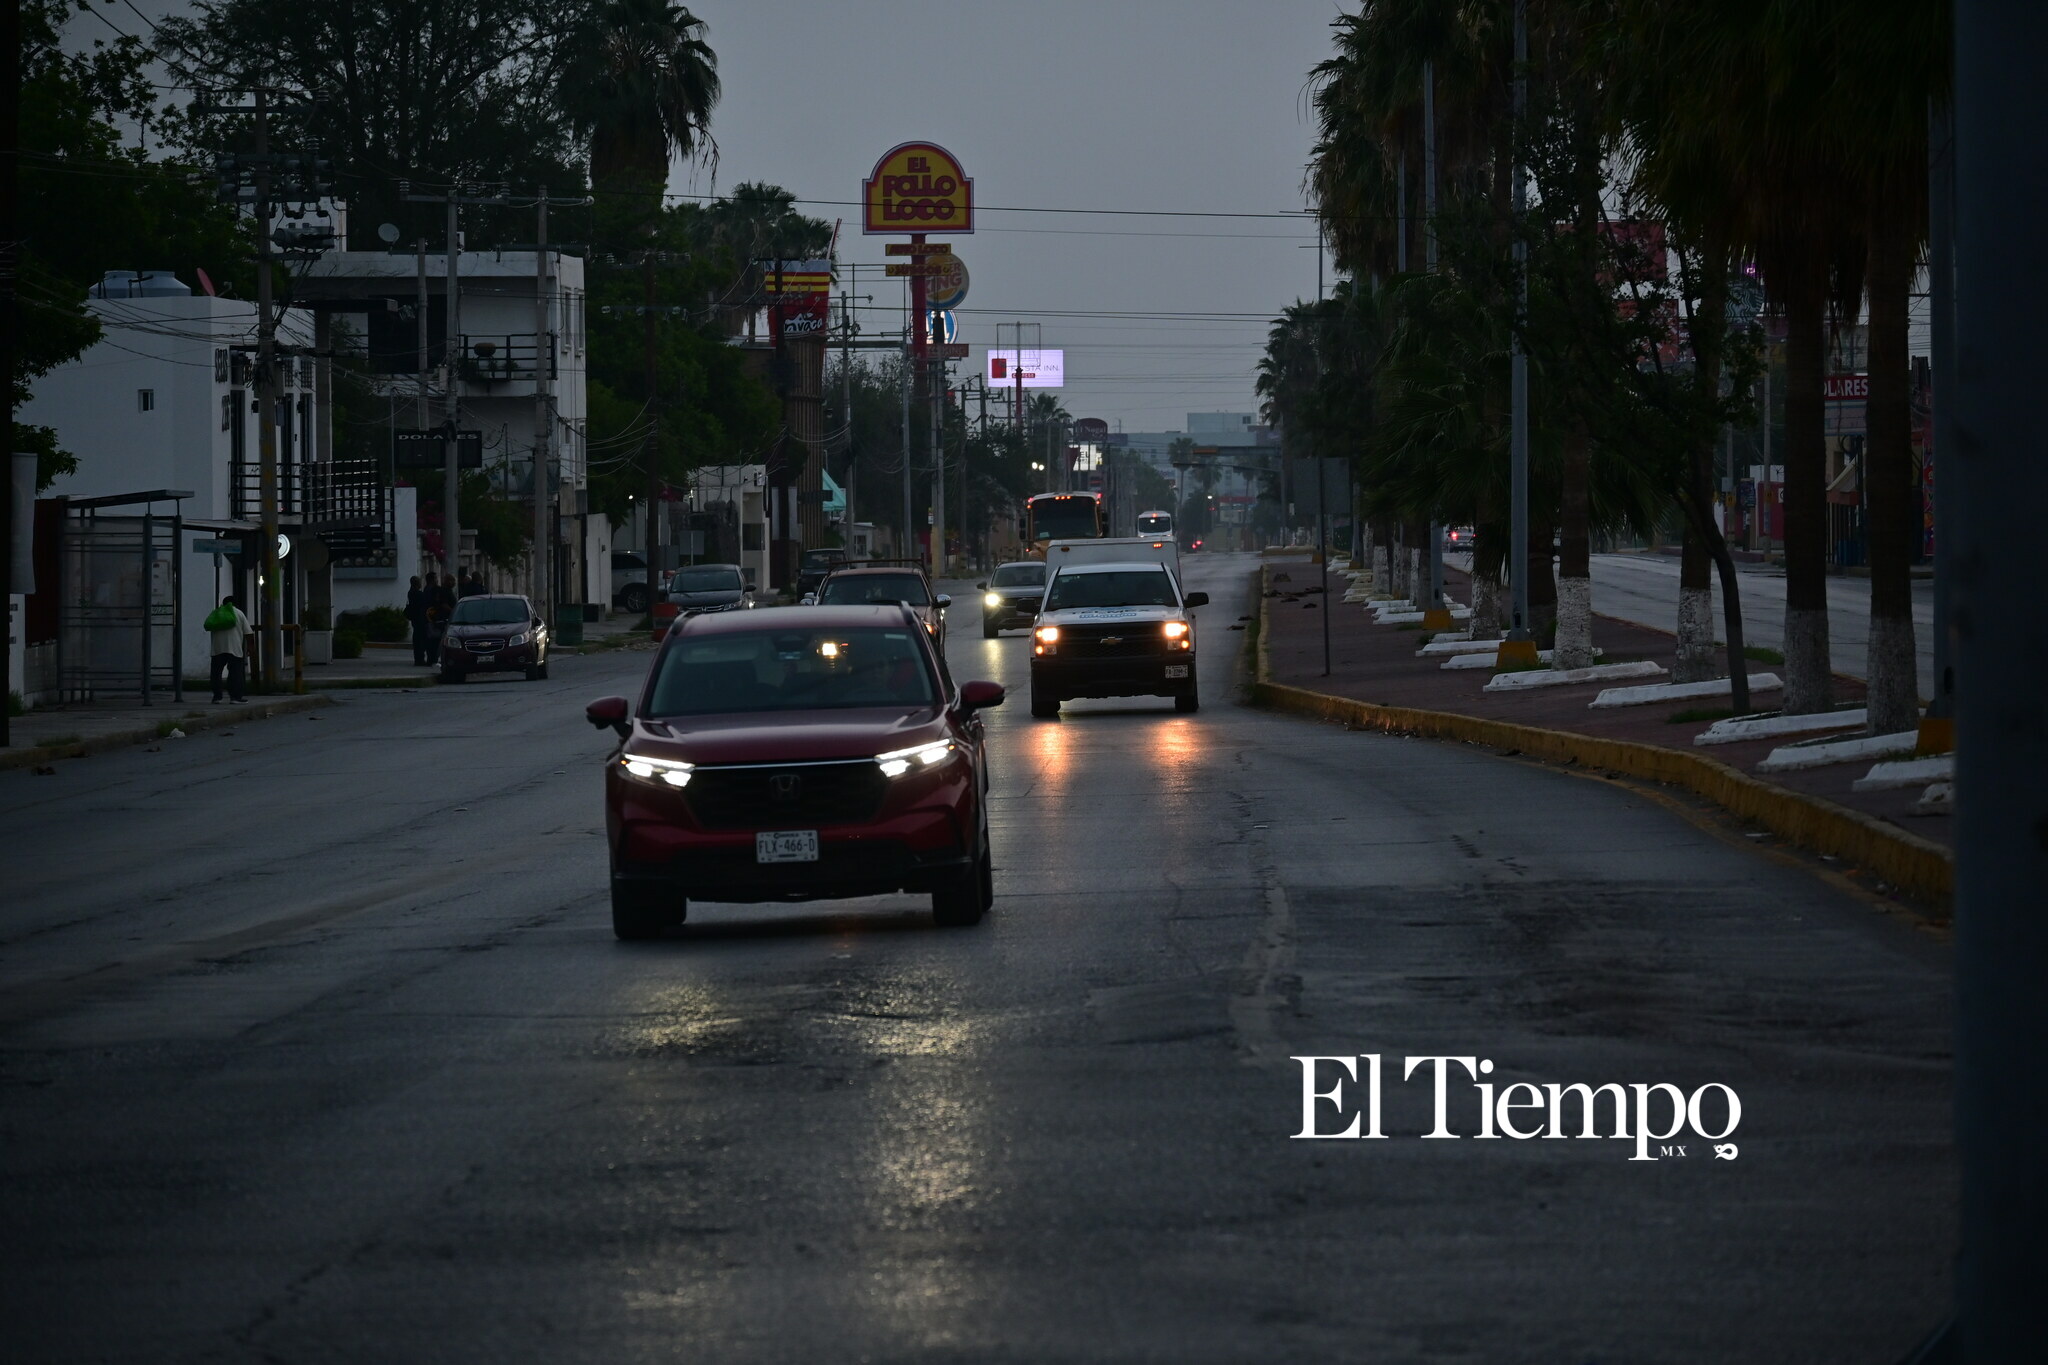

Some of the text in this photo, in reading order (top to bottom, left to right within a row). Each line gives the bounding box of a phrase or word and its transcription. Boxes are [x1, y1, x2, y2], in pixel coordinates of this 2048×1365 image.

[907, 157, 930, 173] EL
[882, 175, 956, 197] POLLO
[883, 198, 955, 221] LOCO
[1824, 379, 1869, 397] LARES
[758, 838, 815, 854] FLX-466-D
